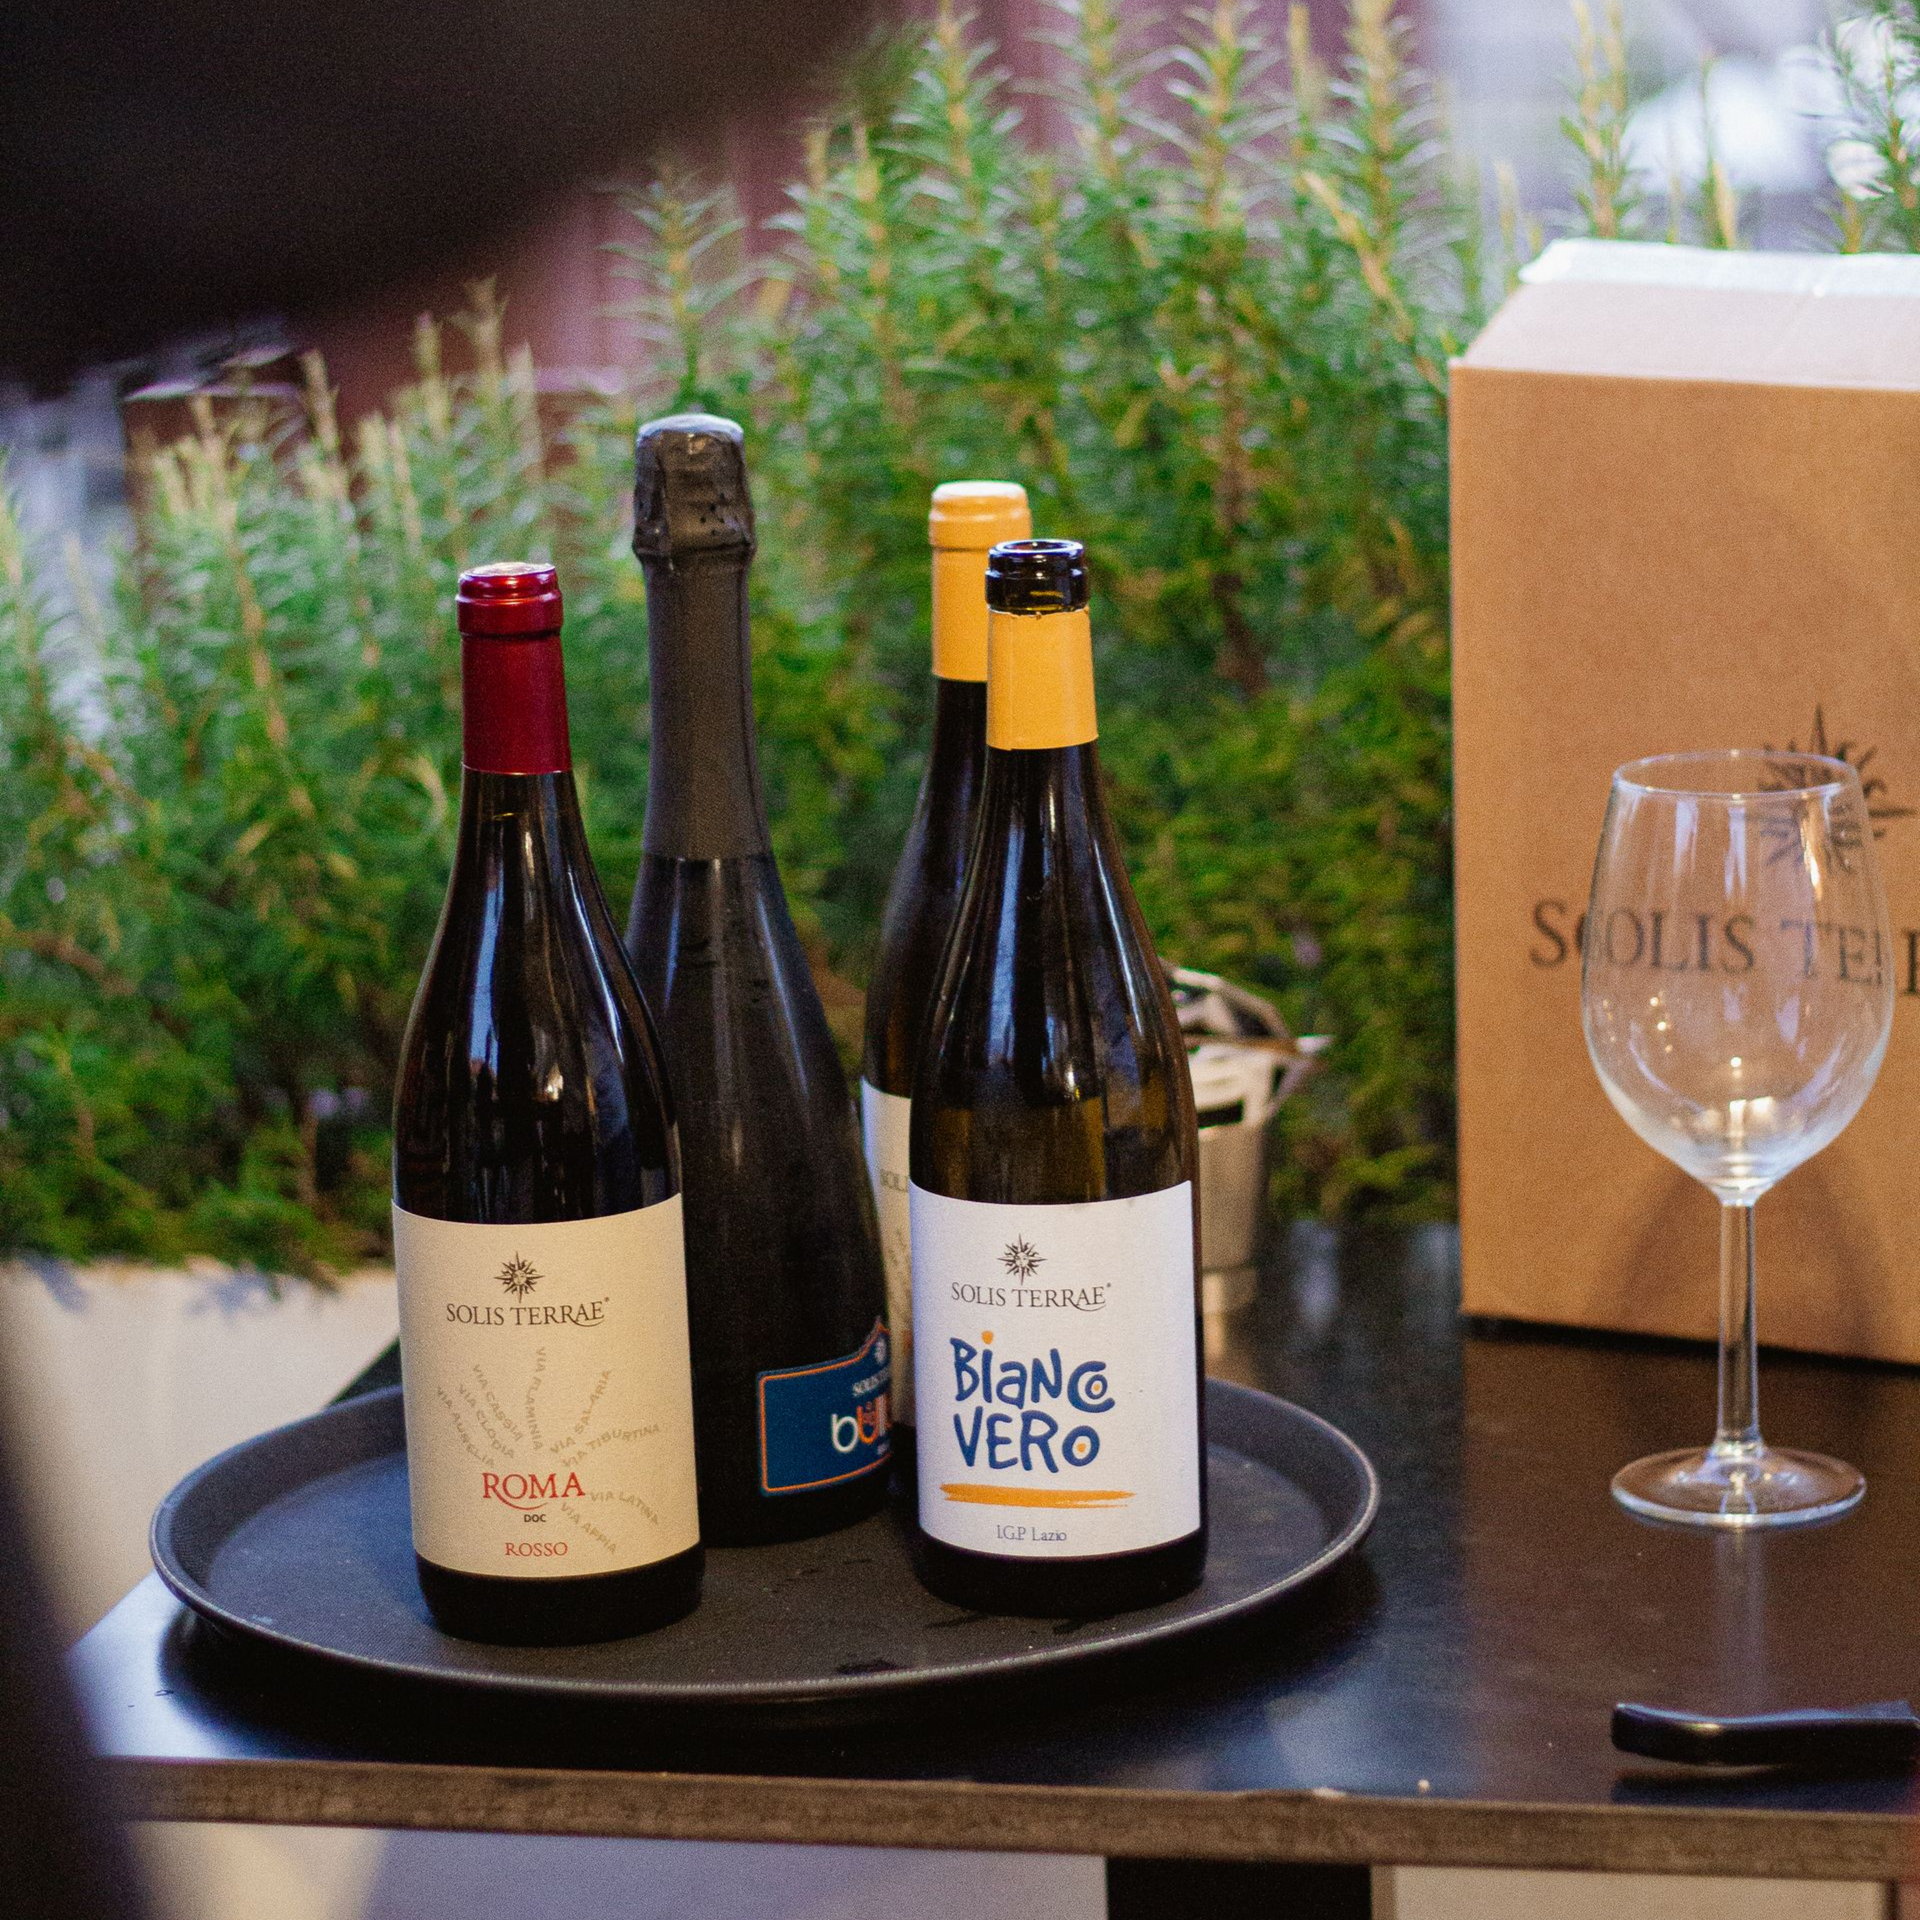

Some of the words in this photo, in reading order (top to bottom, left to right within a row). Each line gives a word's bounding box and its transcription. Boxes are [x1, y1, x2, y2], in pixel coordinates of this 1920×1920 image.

[1529, 897, 1755, 974] SOLIS
[446, 1302, 505, 1326] SOLIS
[951, 1281, 1006, 1308] SOLIS
[534, 1346, 547, 1373] VIA
[459, 1384, 476, 1408] VIA
[476, 1410, 515, 1459] CLODIA
[472, 1364, 488, 1389] VIA
[485, 1391, 523, 1442] CASSIA
[525, 1376, 544, 1451] FLAMINIA
[549, 1436, 576, 1454] VIA
[574, 1370, 612, 1435] SALARIA
[437, 1386, 453, 1409] VIA
[451, 1412, 495, 1467] AURELIA
[561, 1450, 588, 1467] VIA
[585, 1423, 660, 1451] TIBURTINA
[953, 1405, 1100, 1474] VERO
[482, 1470, 586, 1510] ROMA
[590, 1490, 614, 1502] VIA
[618, 1491, 658, 1525] LATINA
[523, 1514, 547, 1524] DOC
[561, 1502, 580, 1524] VIA
[581, 1522, 617, 1555] APPIA
[1031, 1526, 1068, 1542] Lazio
[504, 1541, 568, 1557] ROSSO
